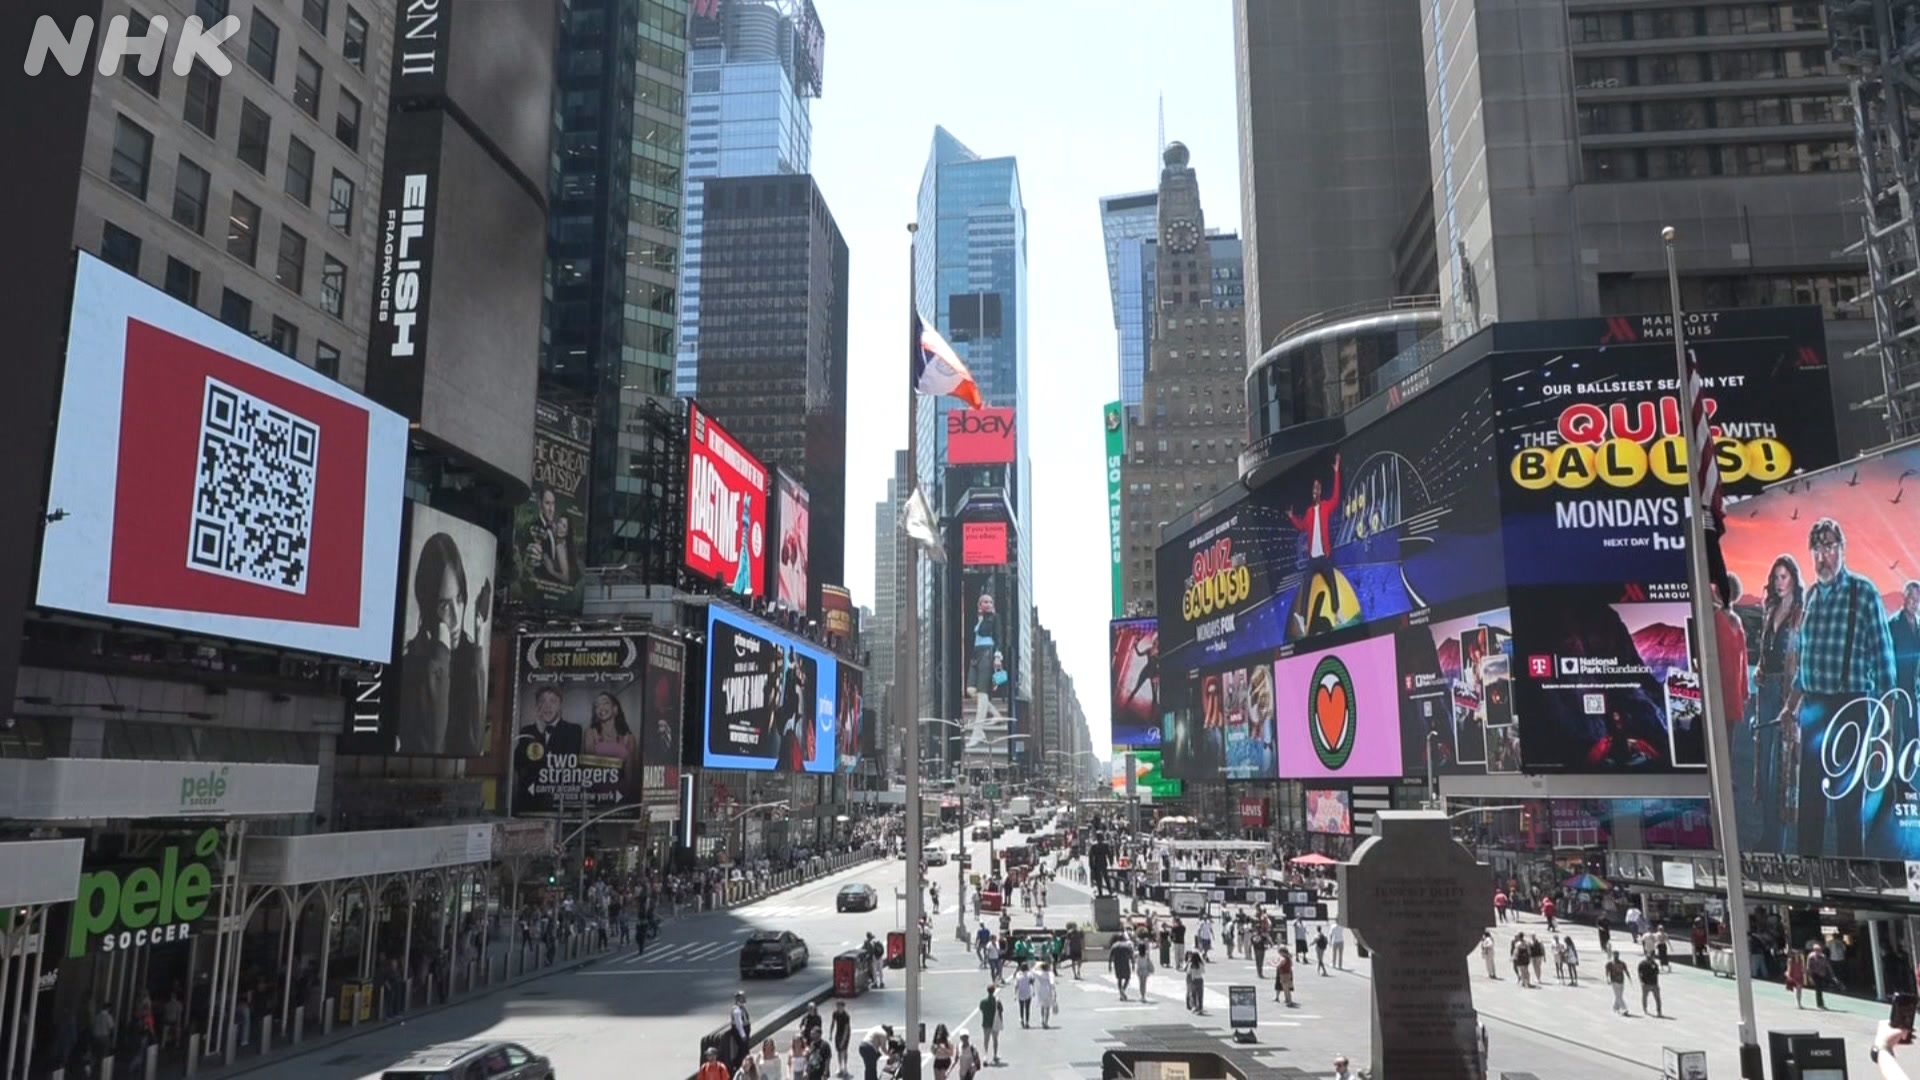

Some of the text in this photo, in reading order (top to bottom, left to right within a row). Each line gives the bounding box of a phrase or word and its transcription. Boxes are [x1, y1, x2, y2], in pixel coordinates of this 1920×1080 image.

[379, 209, 396, 322] FRAGRANCES
[391, 174, 427, 356] EILISH
[1643, 312, 1720, 326] MAROTT
[1644, 325, 1712, 337] MARUIS
[1543, 376, 1745, 395] OUR BALLSIEST SEAON YET
[947, 410, 1015, 438] ebay
[1521, 422, 1777, 447] THE WITH
[550, 444, 590, 475] GREAT
[1516, 438, 1781, 482] BALLS!
[533, 460, 582, 493] GATSBY
[690, 453, 740, 563] RAGTIME
[1556, 496, 1678, 528] MONDAYS
[1604, 533, 1686, 549] NEXT DAY hu
[1192, 536, 1232, 584] QUIZ
[1184, 567, 1248, 617] BALLS!
[1648, 583, 1689, 591] MARRIO
[1649, 591, 1690, 599] MARQUI
[1220, 612, 1236, 635] FOX
[544, 651, 619, 666] BEST MUSICAL
[1532, 658, 1546, 674] T
[1580, 665, 1602, 674] Park
[1579, 656, 1618, 665] National
[547, 752, 577, 769] two
[182, 765, 229, 805] pelé
[539, 767, 619, 787] strangers
[69, 828, 219, 959] pelé
[103, 923, 190, 952] SOCCER
